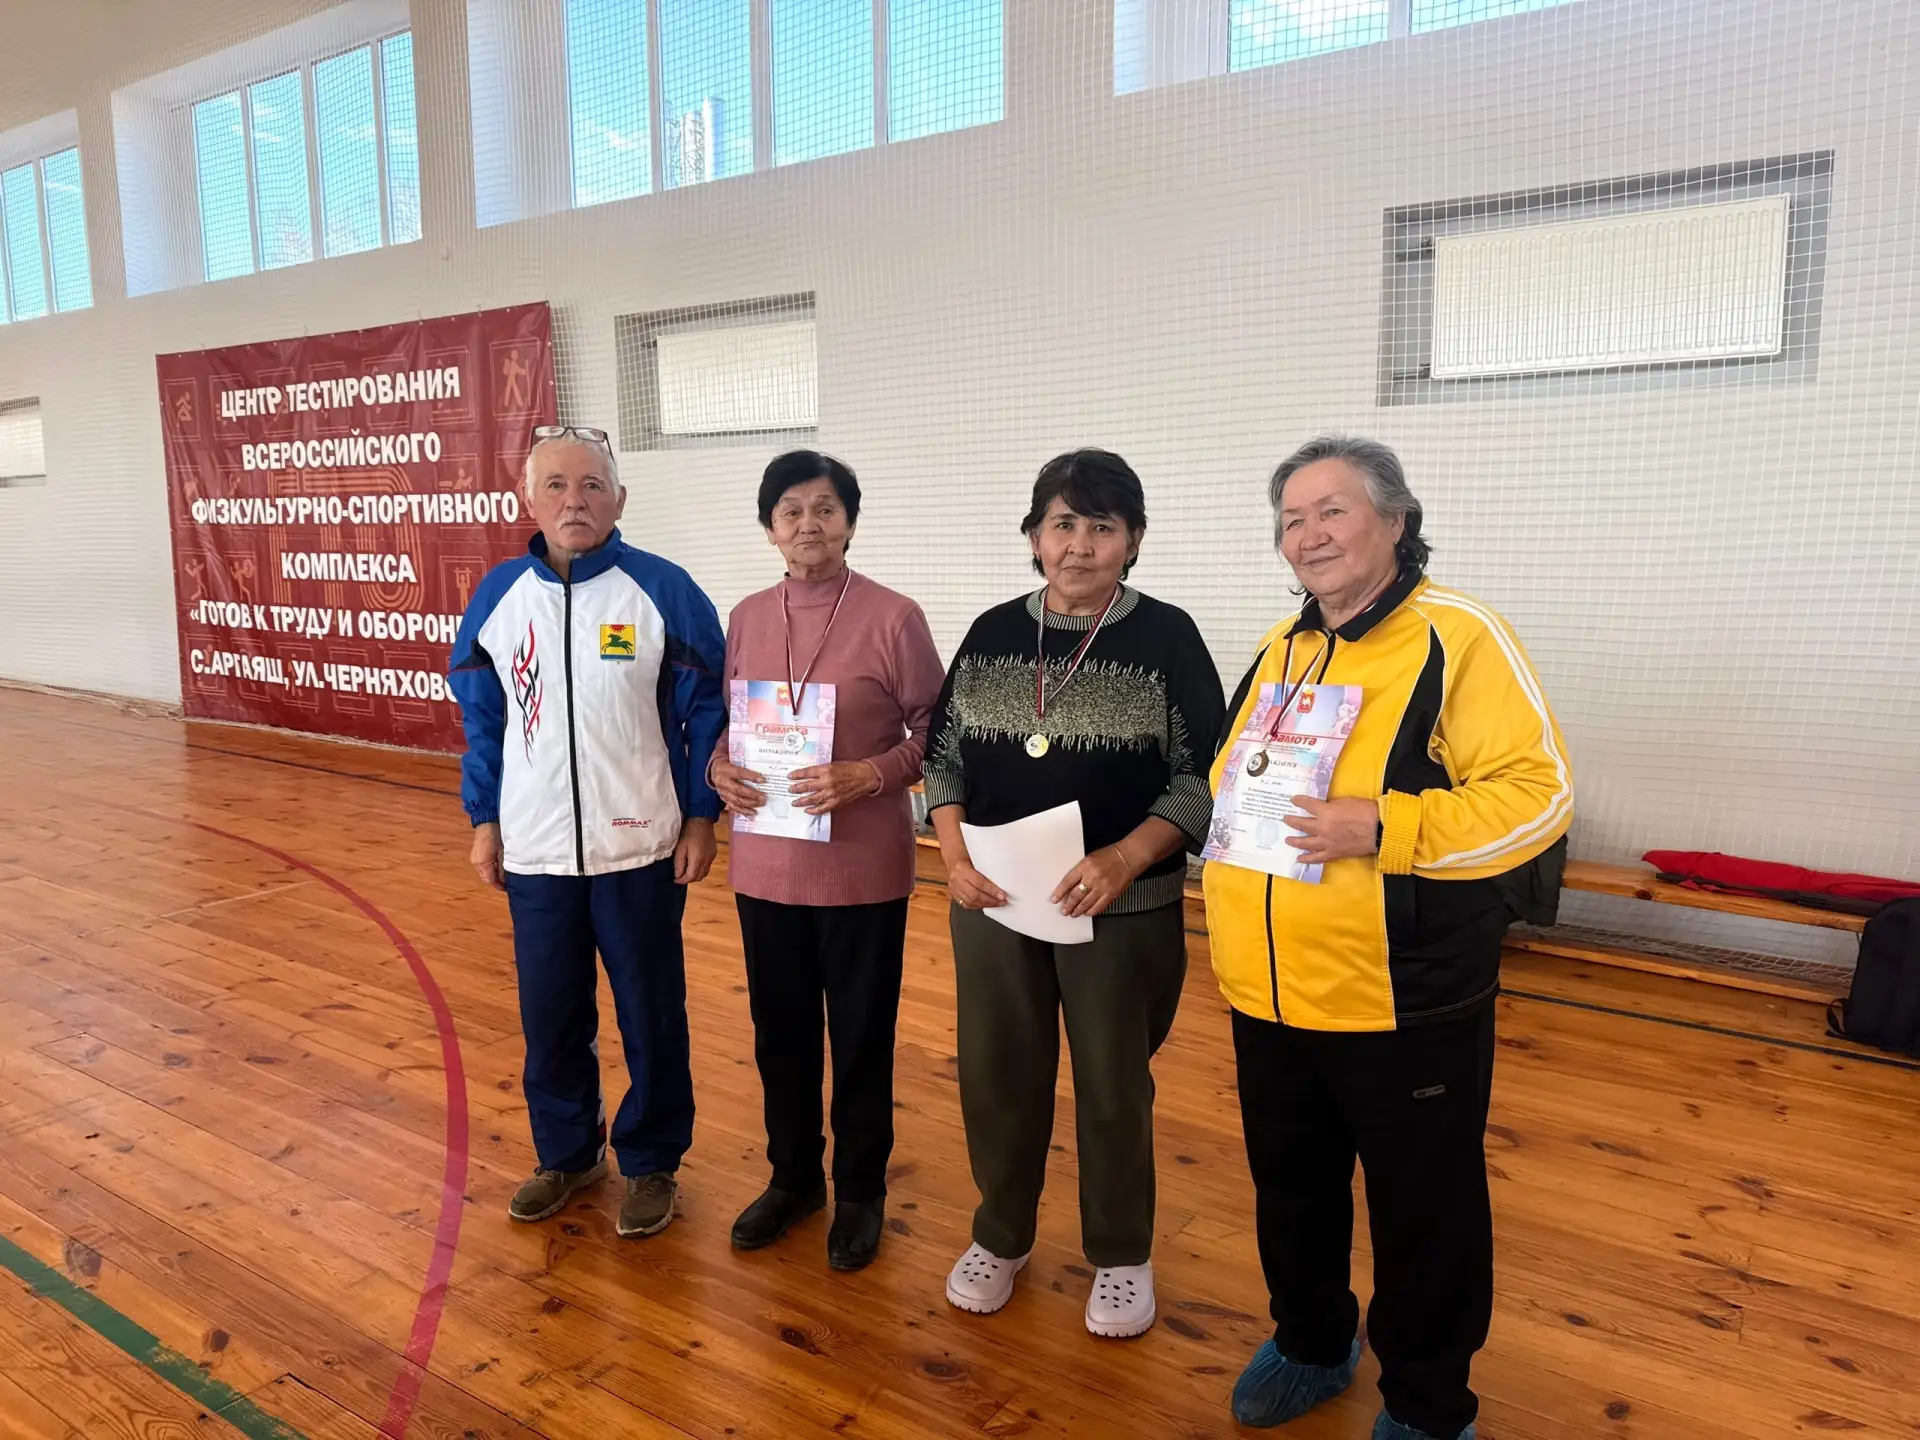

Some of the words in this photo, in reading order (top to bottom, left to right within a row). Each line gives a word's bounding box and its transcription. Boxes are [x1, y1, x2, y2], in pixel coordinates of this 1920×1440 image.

[221, 386, 282, 422] ЦЕНТР
[285, 366, 460, 412] ТЕСТИРОВАНИЯ
[241, 428, 441, 471] ВСЕРОССИЙСКОГО
[191, 492, 519, 525] ФИЗКУЛЬТУРНО-СПОРТИВНОГО
[281, 552, 418, 583] КОМПЛЕКСА
[253, 604, 269, 631] К
[270, 606, 332, 640] ТРУДУ
[337, 609, 353, 637] И
